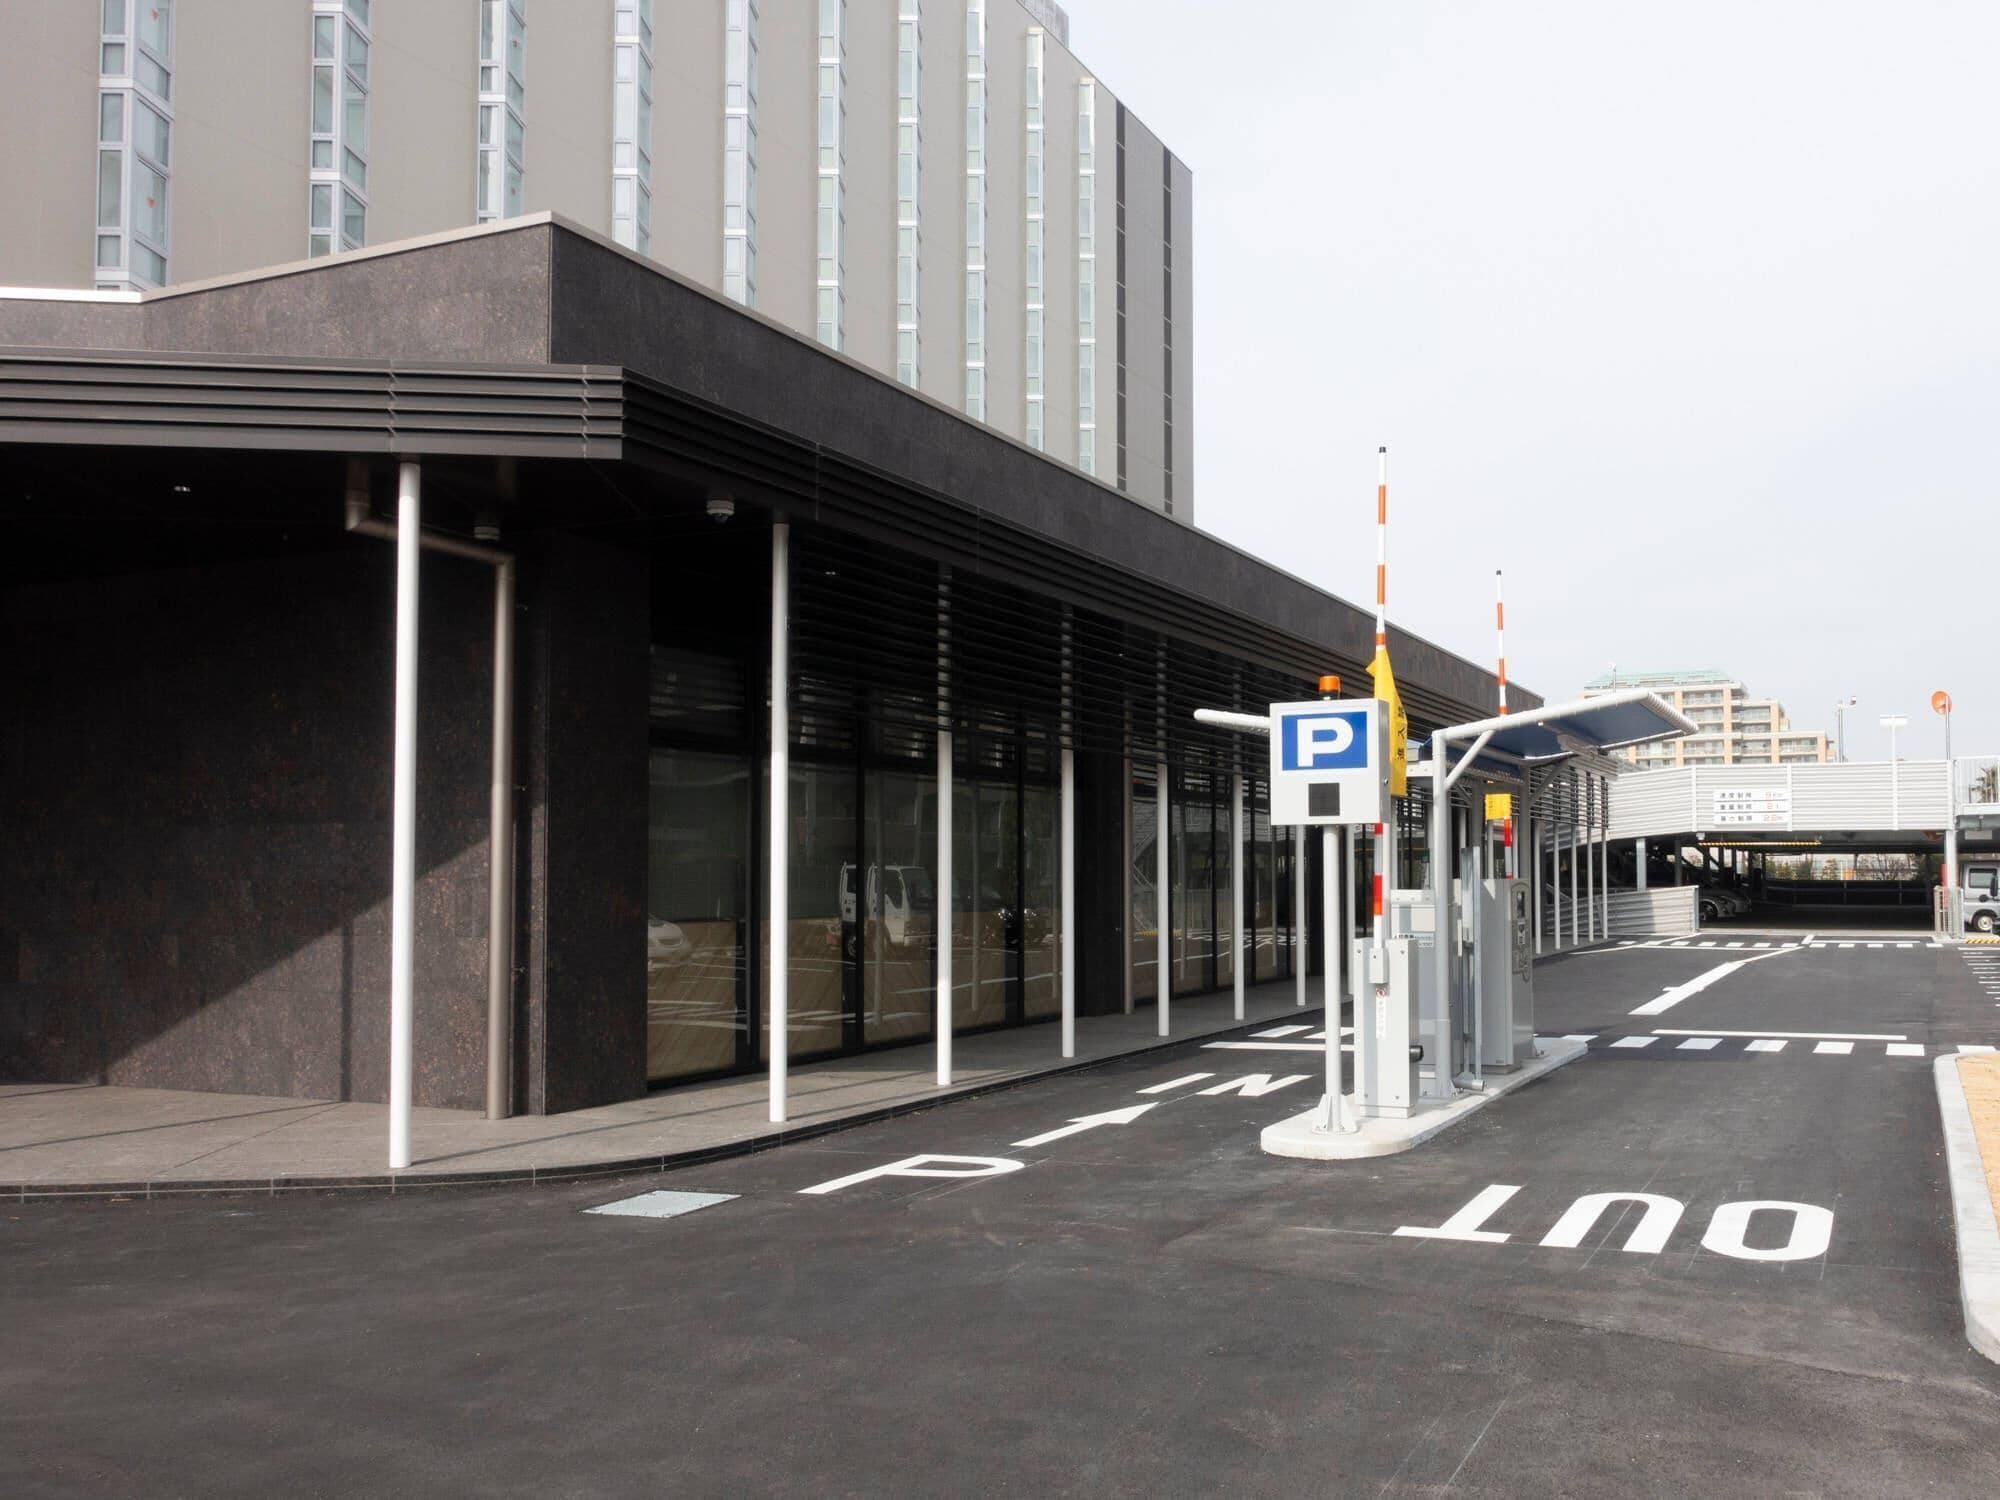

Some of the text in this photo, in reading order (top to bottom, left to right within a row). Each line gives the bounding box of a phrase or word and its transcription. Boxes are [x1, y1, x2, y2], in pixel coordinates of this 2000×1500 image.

[1297, 717, 1354, 767] P
[1136, 1072, 1314, 1096] IN
[796, 1153, 1027, 1194] P
[1392, 1184, 1835, 1261] OUT
